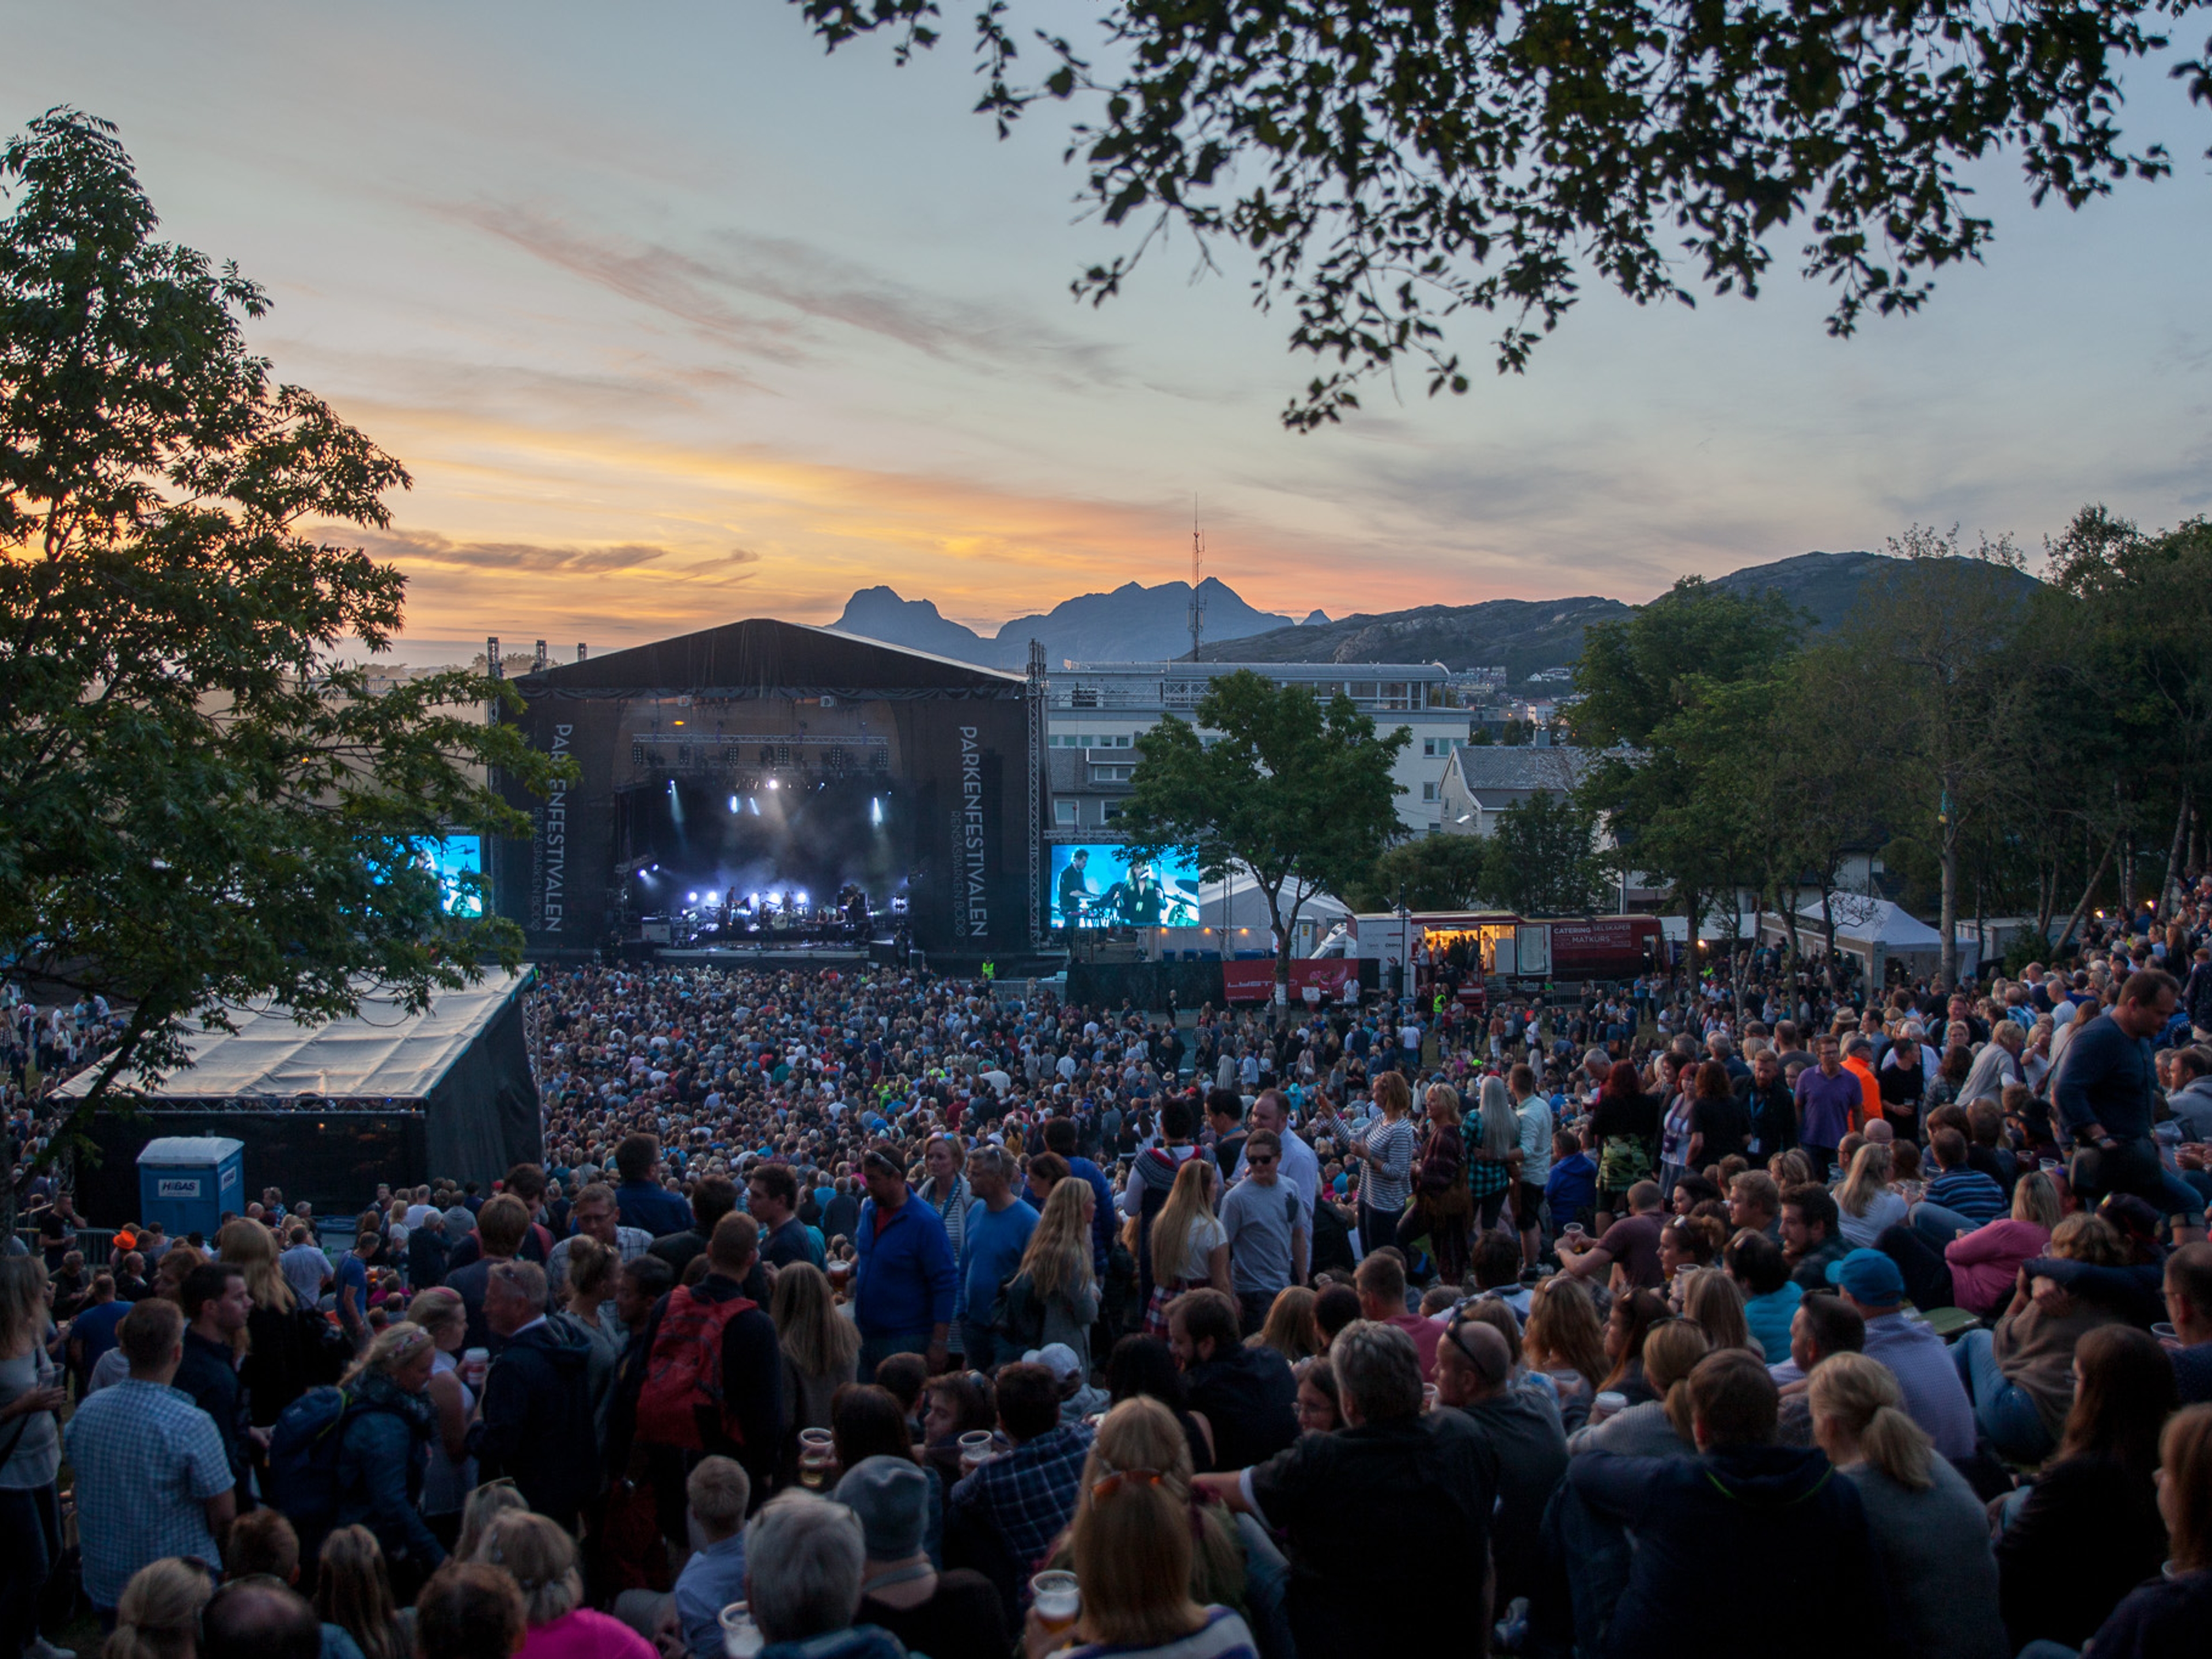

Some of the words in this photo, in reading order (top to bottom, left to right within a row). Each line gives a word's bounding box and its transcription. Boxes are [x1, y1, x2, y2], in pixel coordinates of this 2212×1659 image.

[545, 724, 573, 932] PARENFESTIVALEN
[950, 810, 964, 899] RENSÅSPARKEN
[959, 726, 988, 936] PARKENFESTIVALEN
[531, 895, 542, 931] BODØ
[954, 901, 966, 937] BODØ
